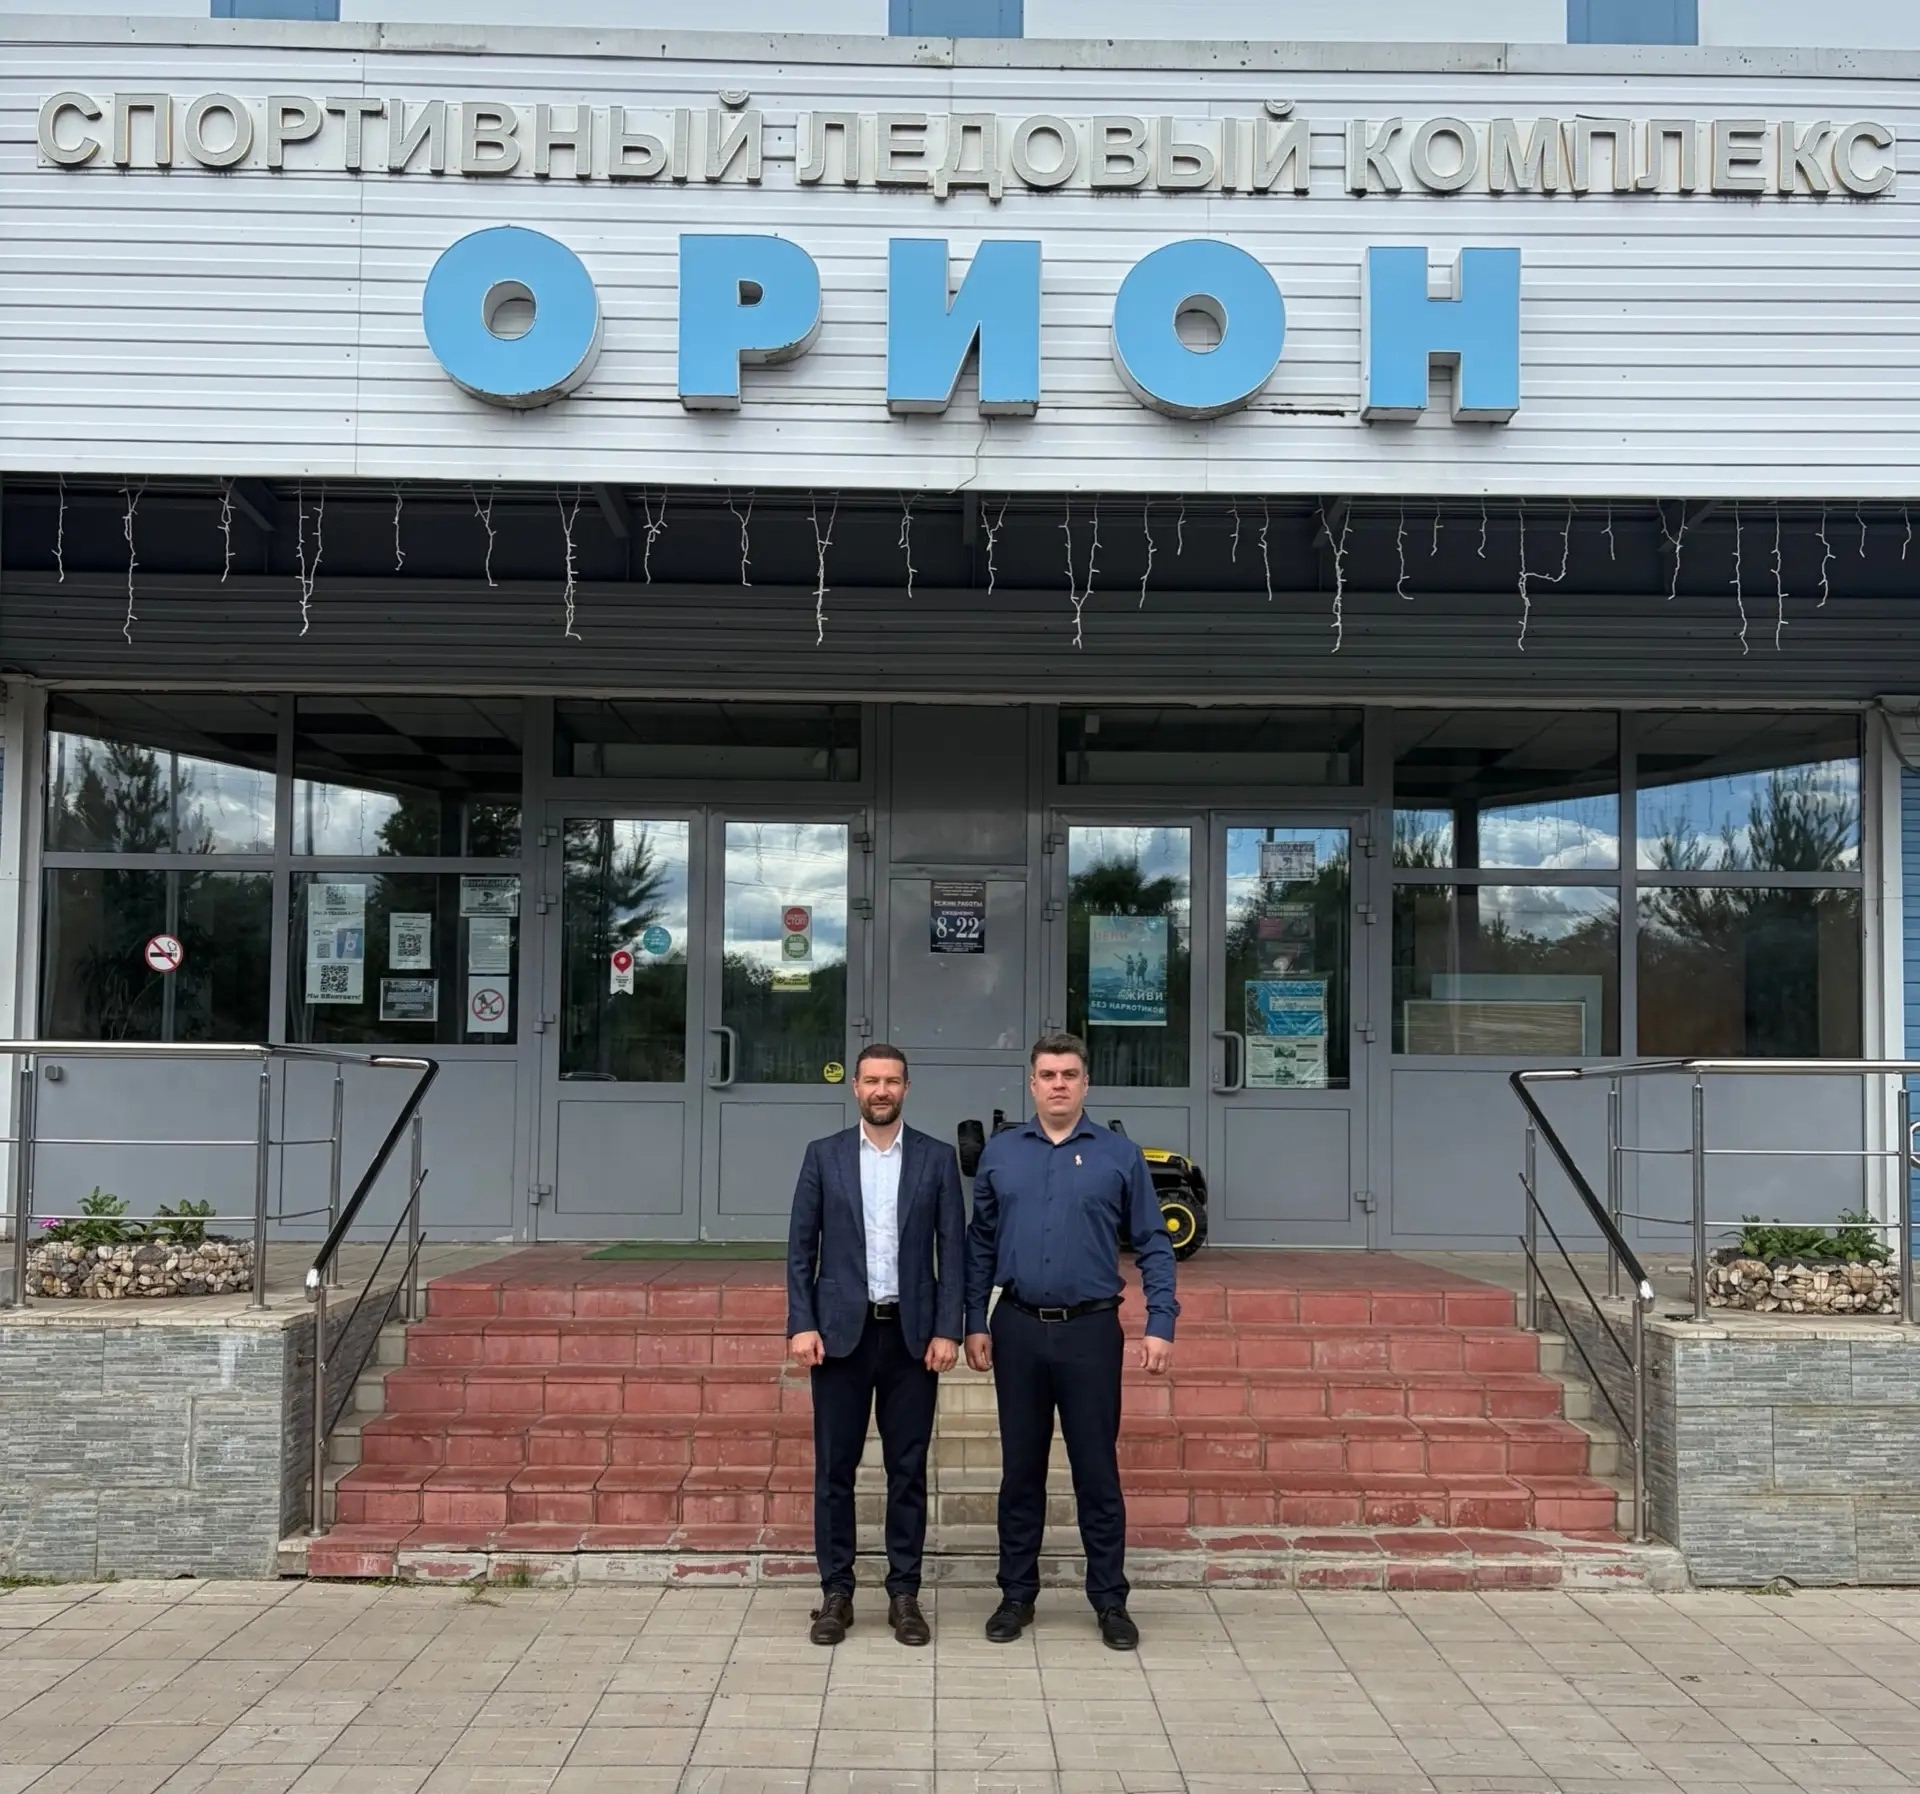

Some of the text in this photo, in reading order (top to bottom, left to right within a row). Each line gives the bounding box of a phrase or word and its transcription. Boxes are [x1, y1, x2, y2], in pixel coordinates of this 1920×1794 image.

[37, 89, 1895, 200] СПОРТИВНЫЙ ЛЕДОВЫЙ КОМПЛЕКС
[423, 224, 1521, 424] ОРИОН
[1090, 1000, 1165, 1014] БЕЗ НАРКОТИКОВ
[1127, 991, 1163, 1001] ЖИВИ
